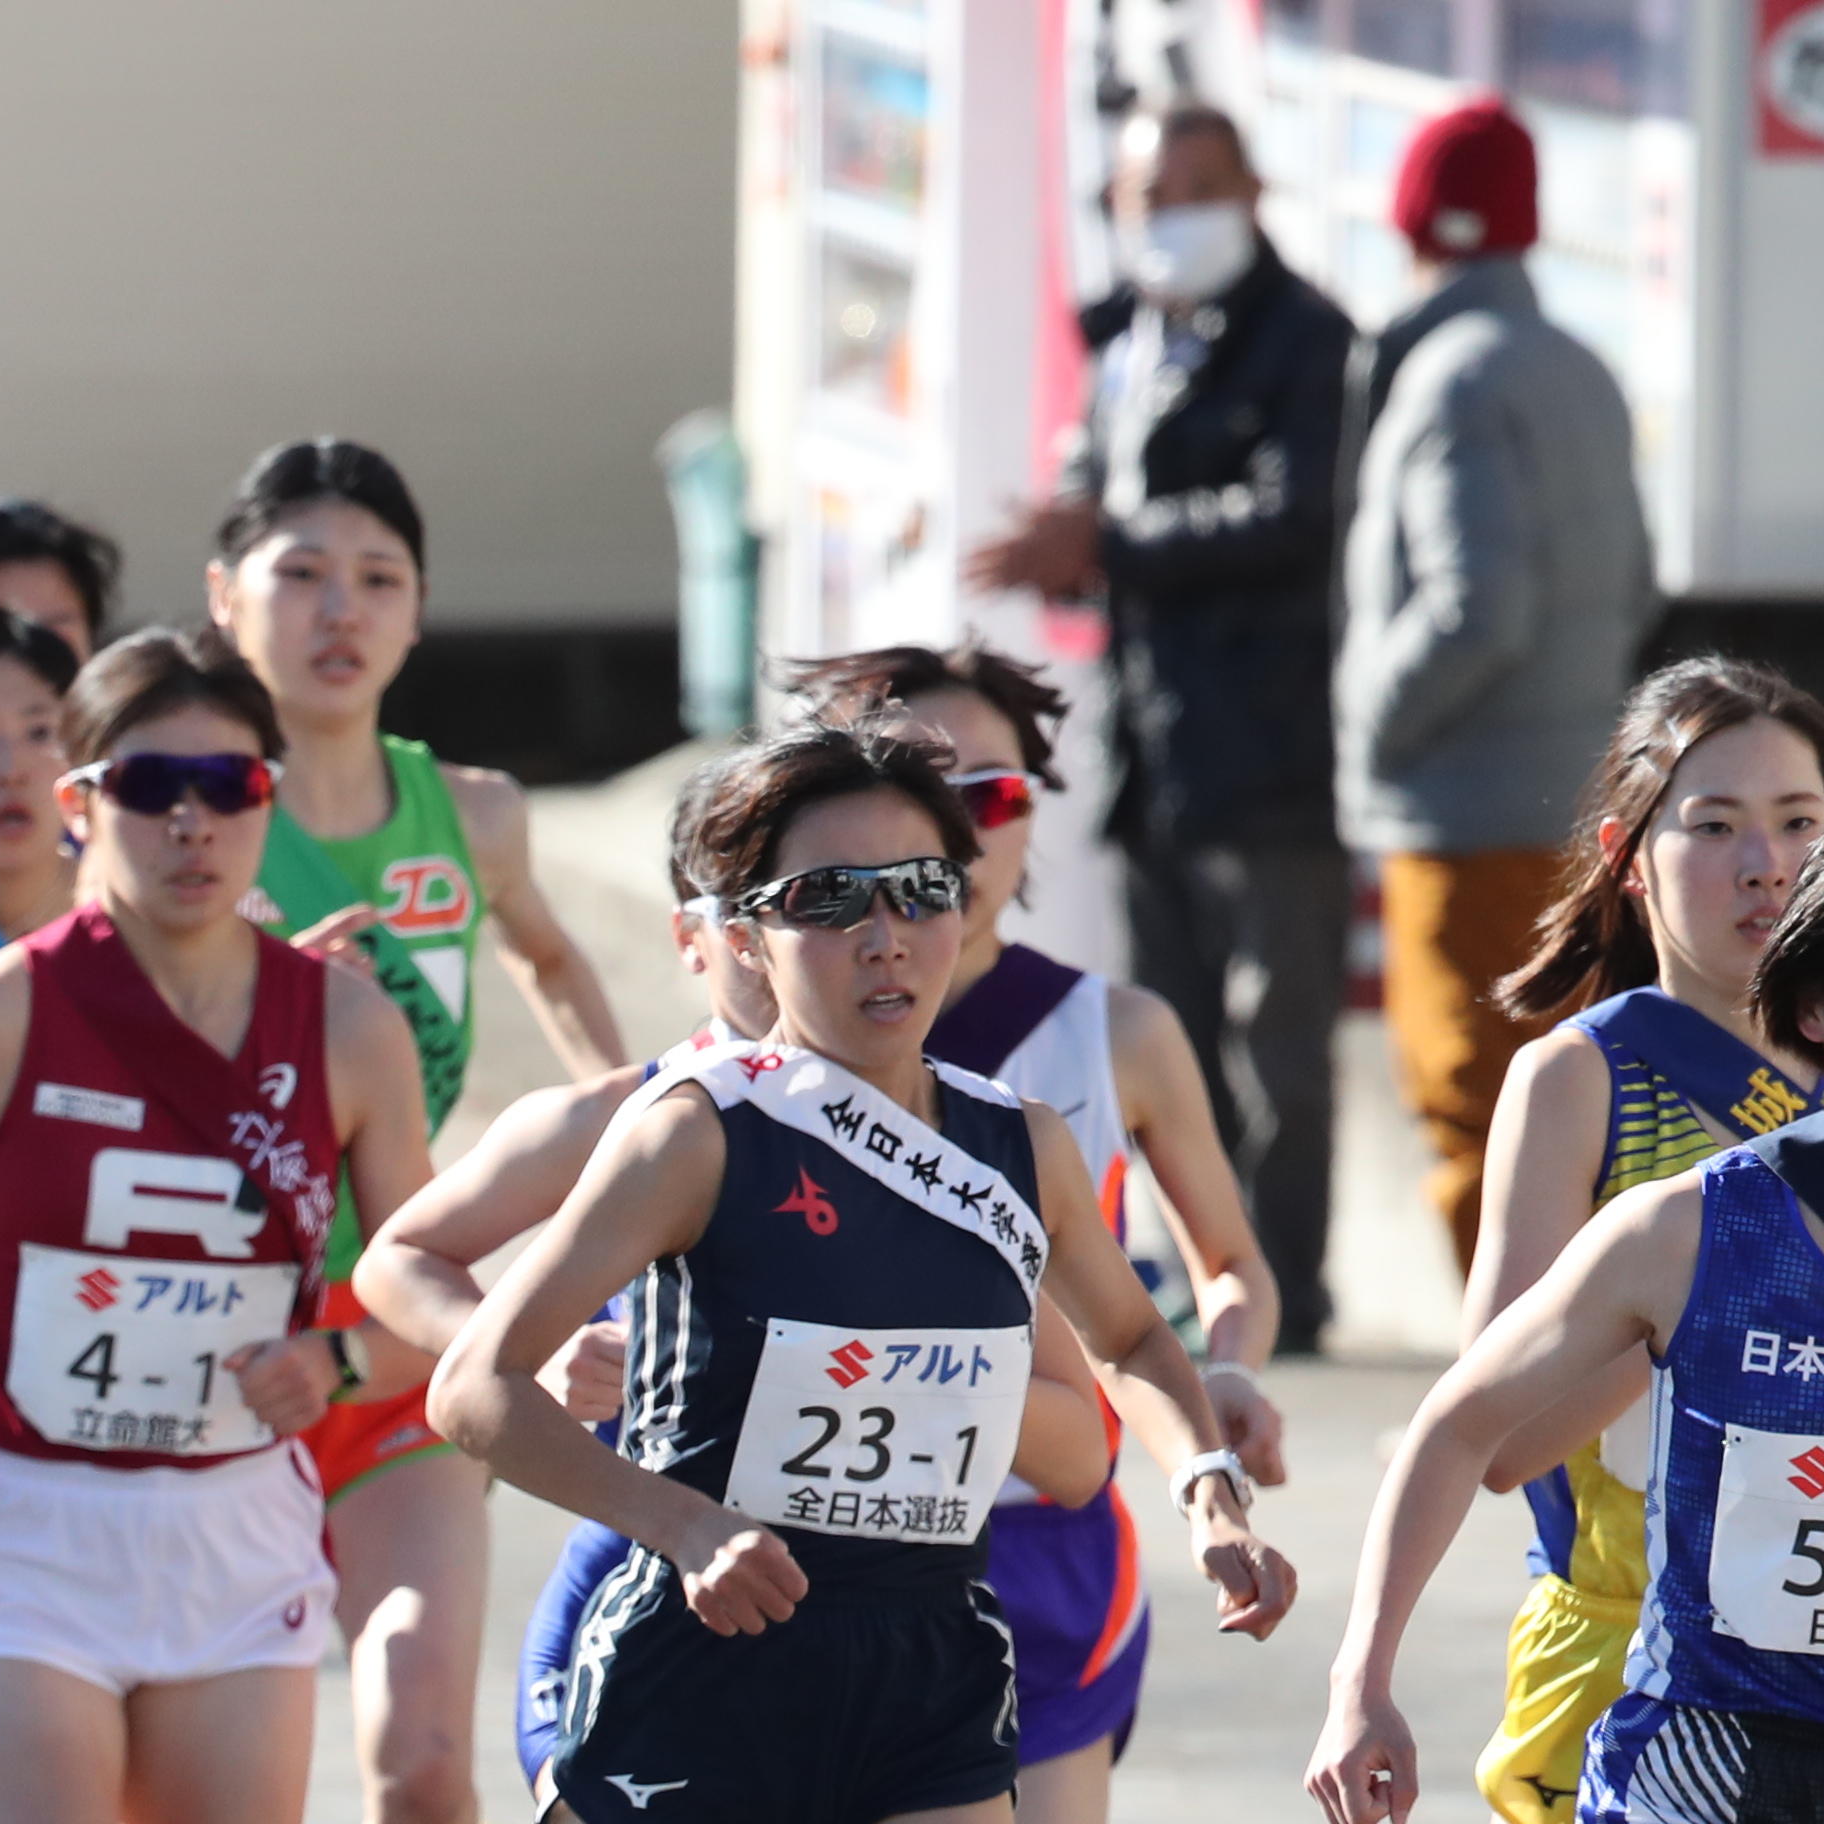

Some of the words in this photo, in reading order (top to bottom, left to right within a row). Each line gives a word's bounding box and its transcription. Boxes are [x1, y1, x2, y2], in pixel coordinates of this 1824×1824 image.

[133, 1275, 245, 1317] アルト
[68, 1333, 218, 1407] 4-1
[881, 1344, 993, 1388] アルト
[71, 1405, 213, 1455] 立命館大
[781, 1405, 982, 1487] 23-1
[783, 1486, 970, 1537] 全日本選抜
